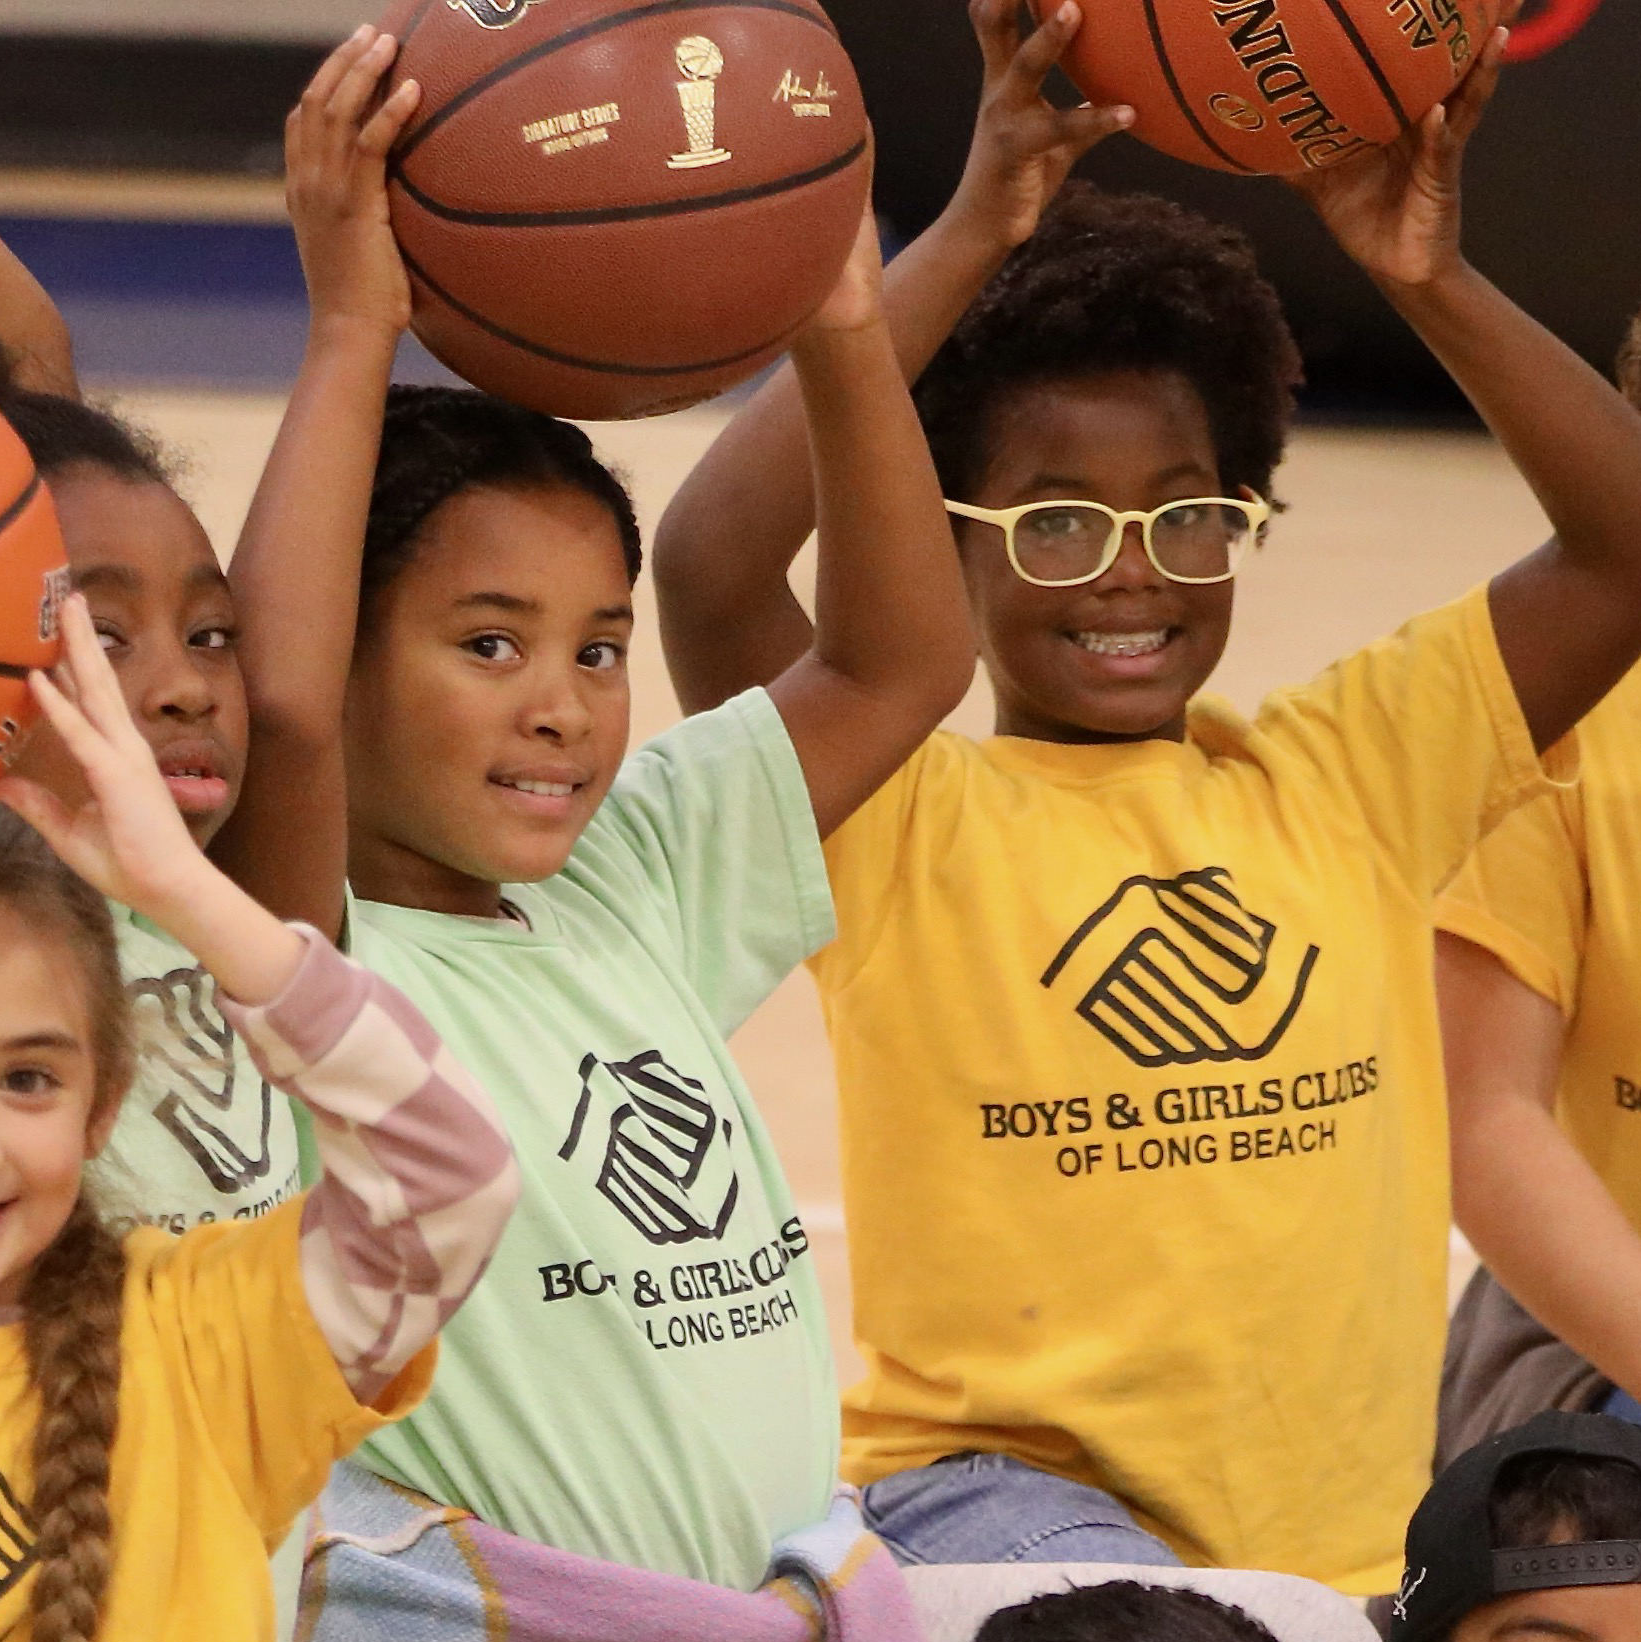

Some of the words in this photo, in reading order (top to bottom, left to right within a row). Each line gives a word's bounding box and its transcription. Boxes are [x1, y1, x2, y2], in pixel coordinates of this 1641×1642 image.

[1210, 0, 1368, 168] PALDIN
[981, 1097, 1092, 1138] BOYS
[1106, 1093, 1143, 1130] &
[1154, 1079, 1285, 1125] GIRLS
[1056, 1144, 1104, 1178] OF
[1116, 1135, 1218, 1172] LONG
[1230, 1120, 1337, 1162] BEACH
[538, 1259, 616, 1302] BO
[633, 1270, 666, 1308] &
[646, 1312, 724, 1350] LONG
[727, 1290, 798, 1339] BEACH
